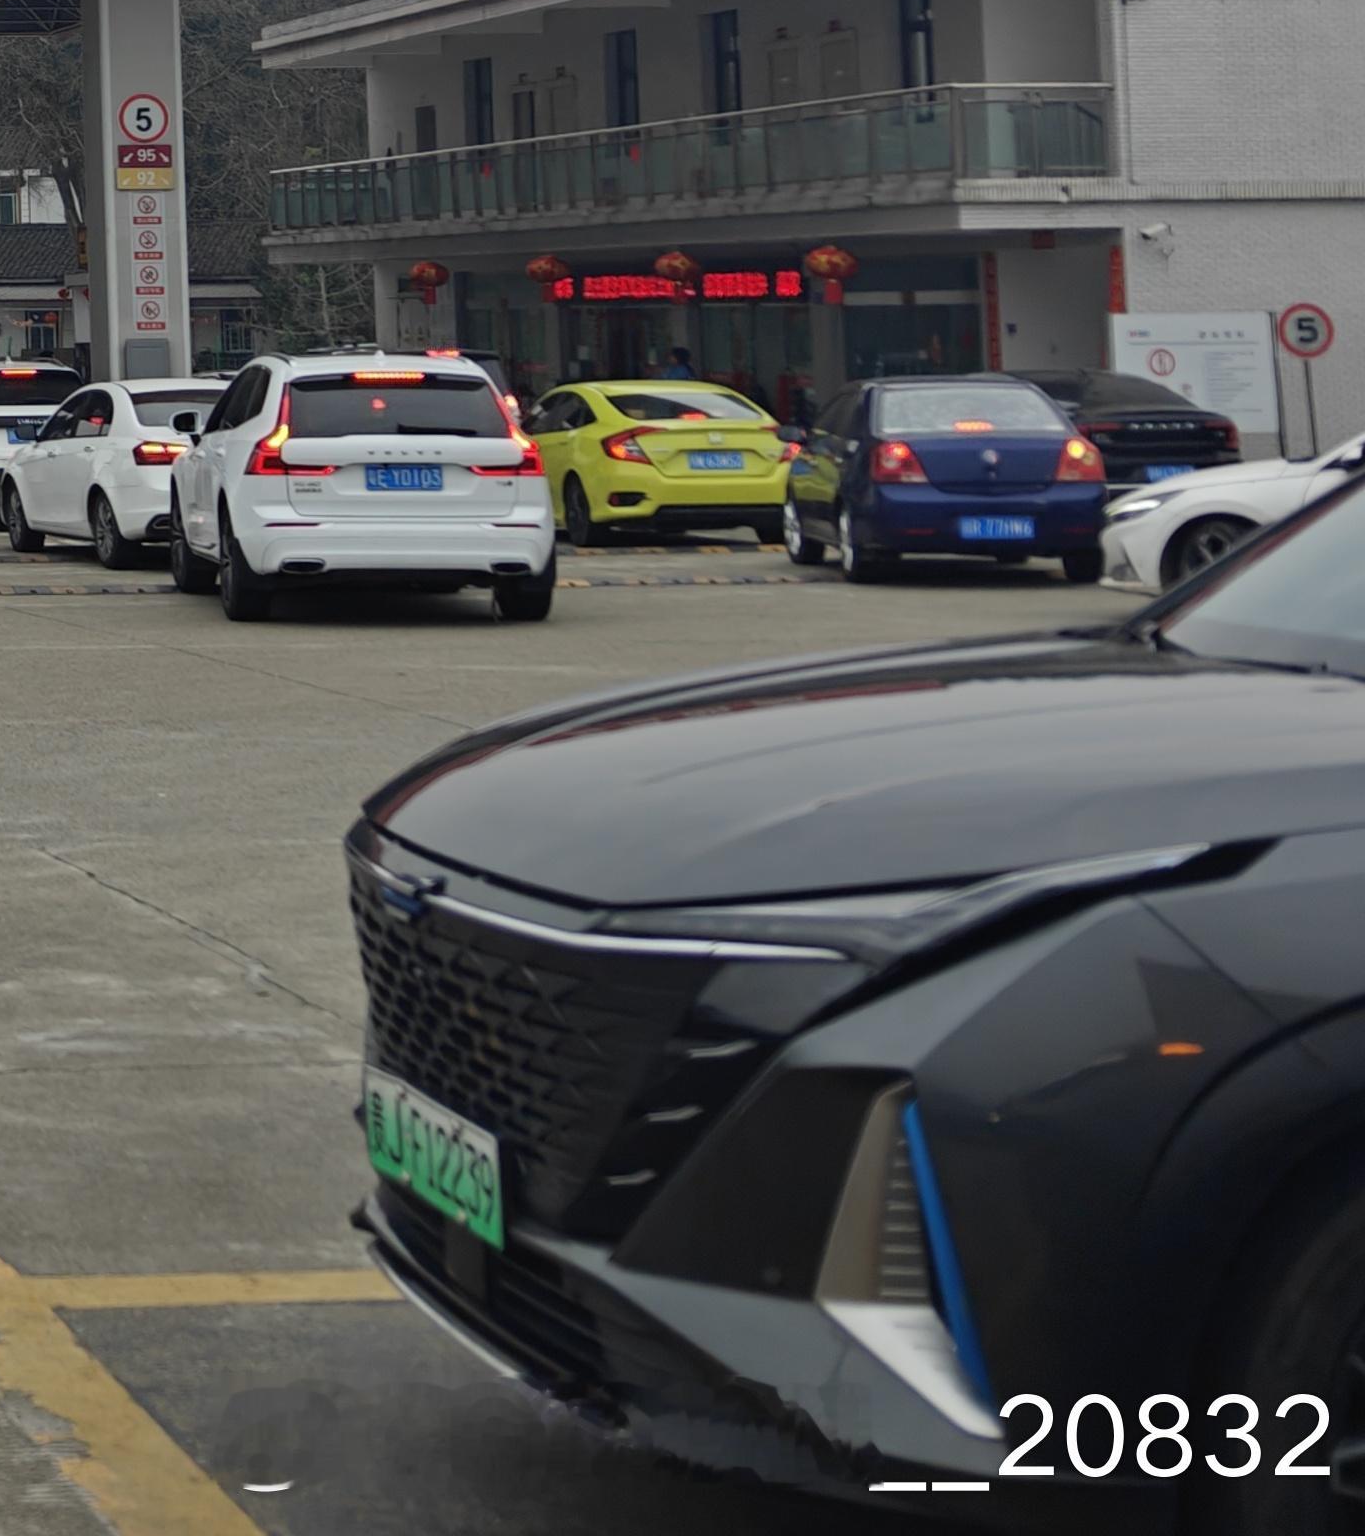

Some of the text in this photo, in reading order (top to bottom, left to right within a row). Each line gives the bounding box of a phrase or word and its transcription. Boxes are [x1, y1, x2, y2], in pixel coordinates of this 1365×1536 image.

[135, 107, 153, 132] 5
[136, 148, 157, 162] 95
[136, 172, 157, 186] 92
[1296, 317, 1319, 344] 5
